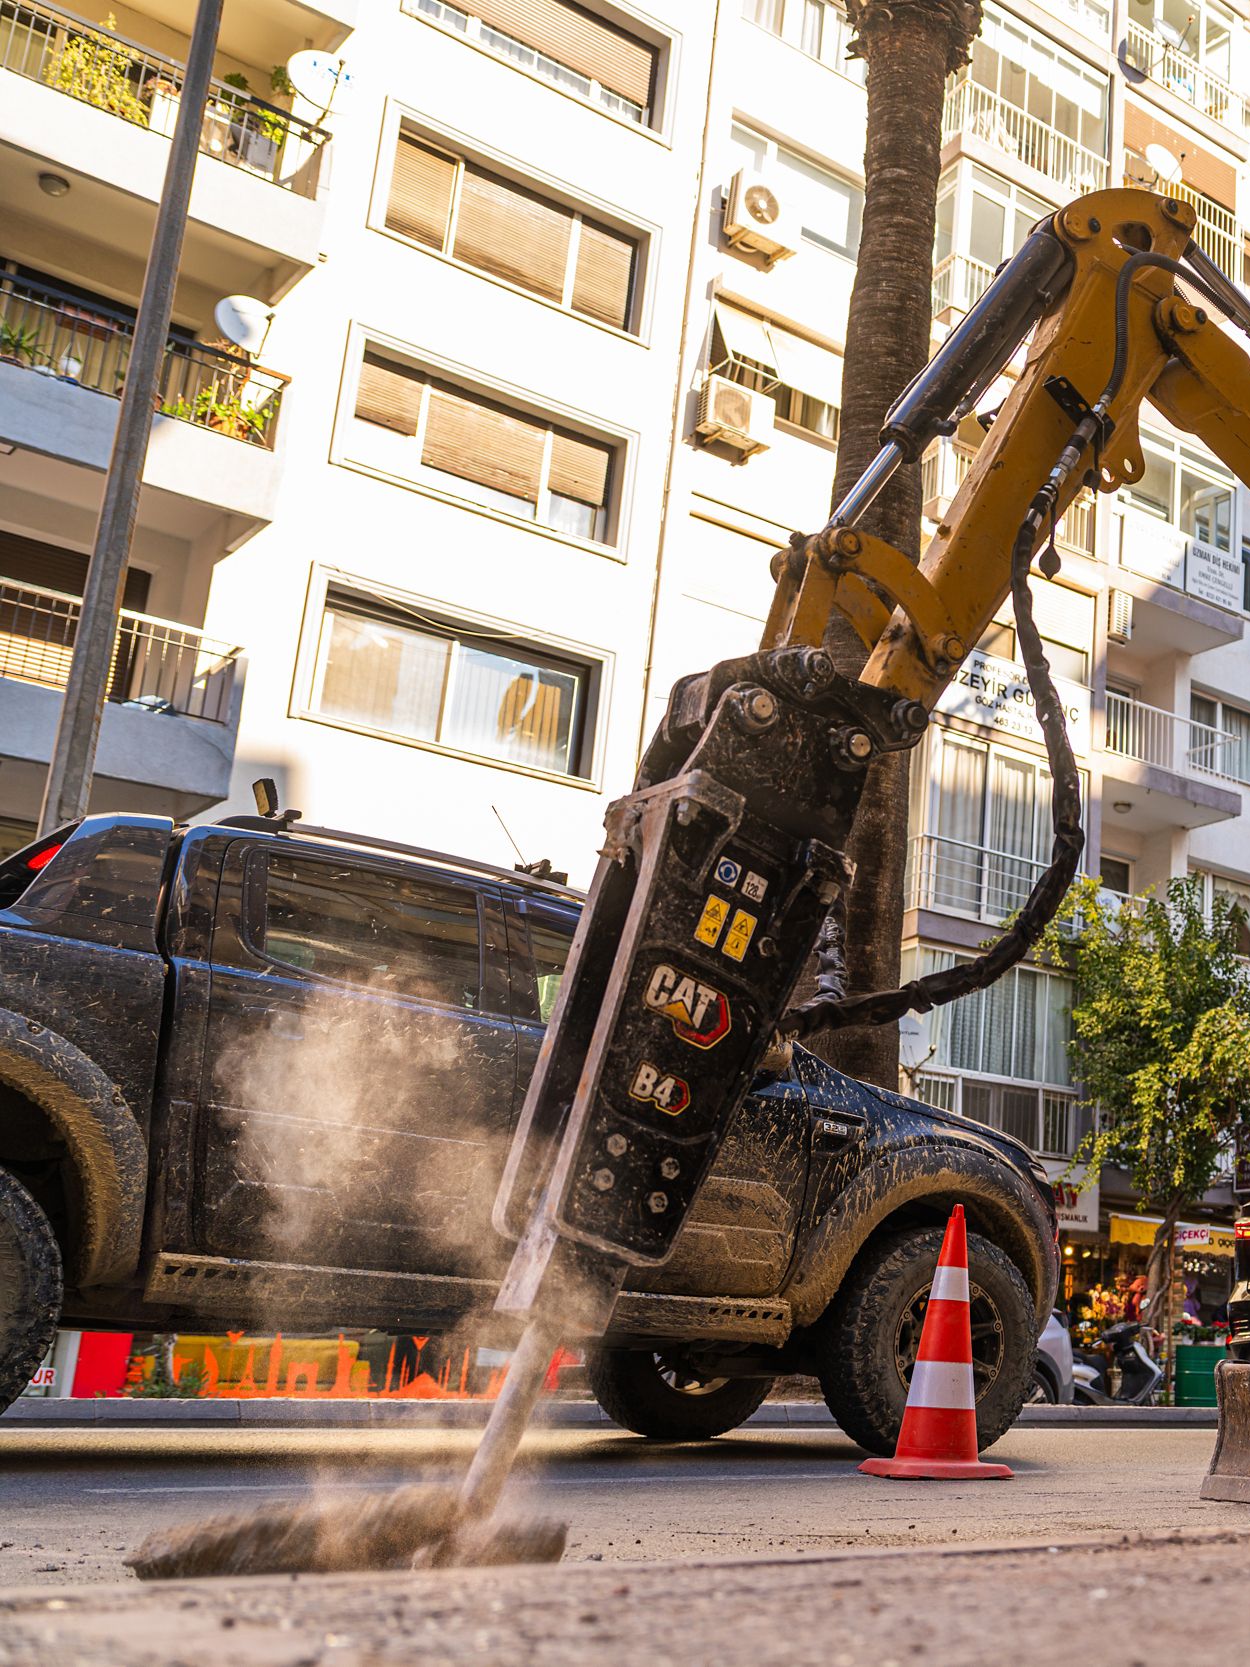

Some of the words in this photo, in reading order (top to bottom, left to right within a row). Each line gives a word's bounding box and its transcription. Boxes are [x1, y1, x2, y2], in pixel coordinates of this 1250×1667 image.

[975, 695, 994, 709] GÖZ
[745, 881, 760, 898] 128
[646, 965, 718, 1029] CAT
[632, 1063, 677, 1108] B4
[1174, 1228, 1209, 1241] ÇİÇEKÇİ
